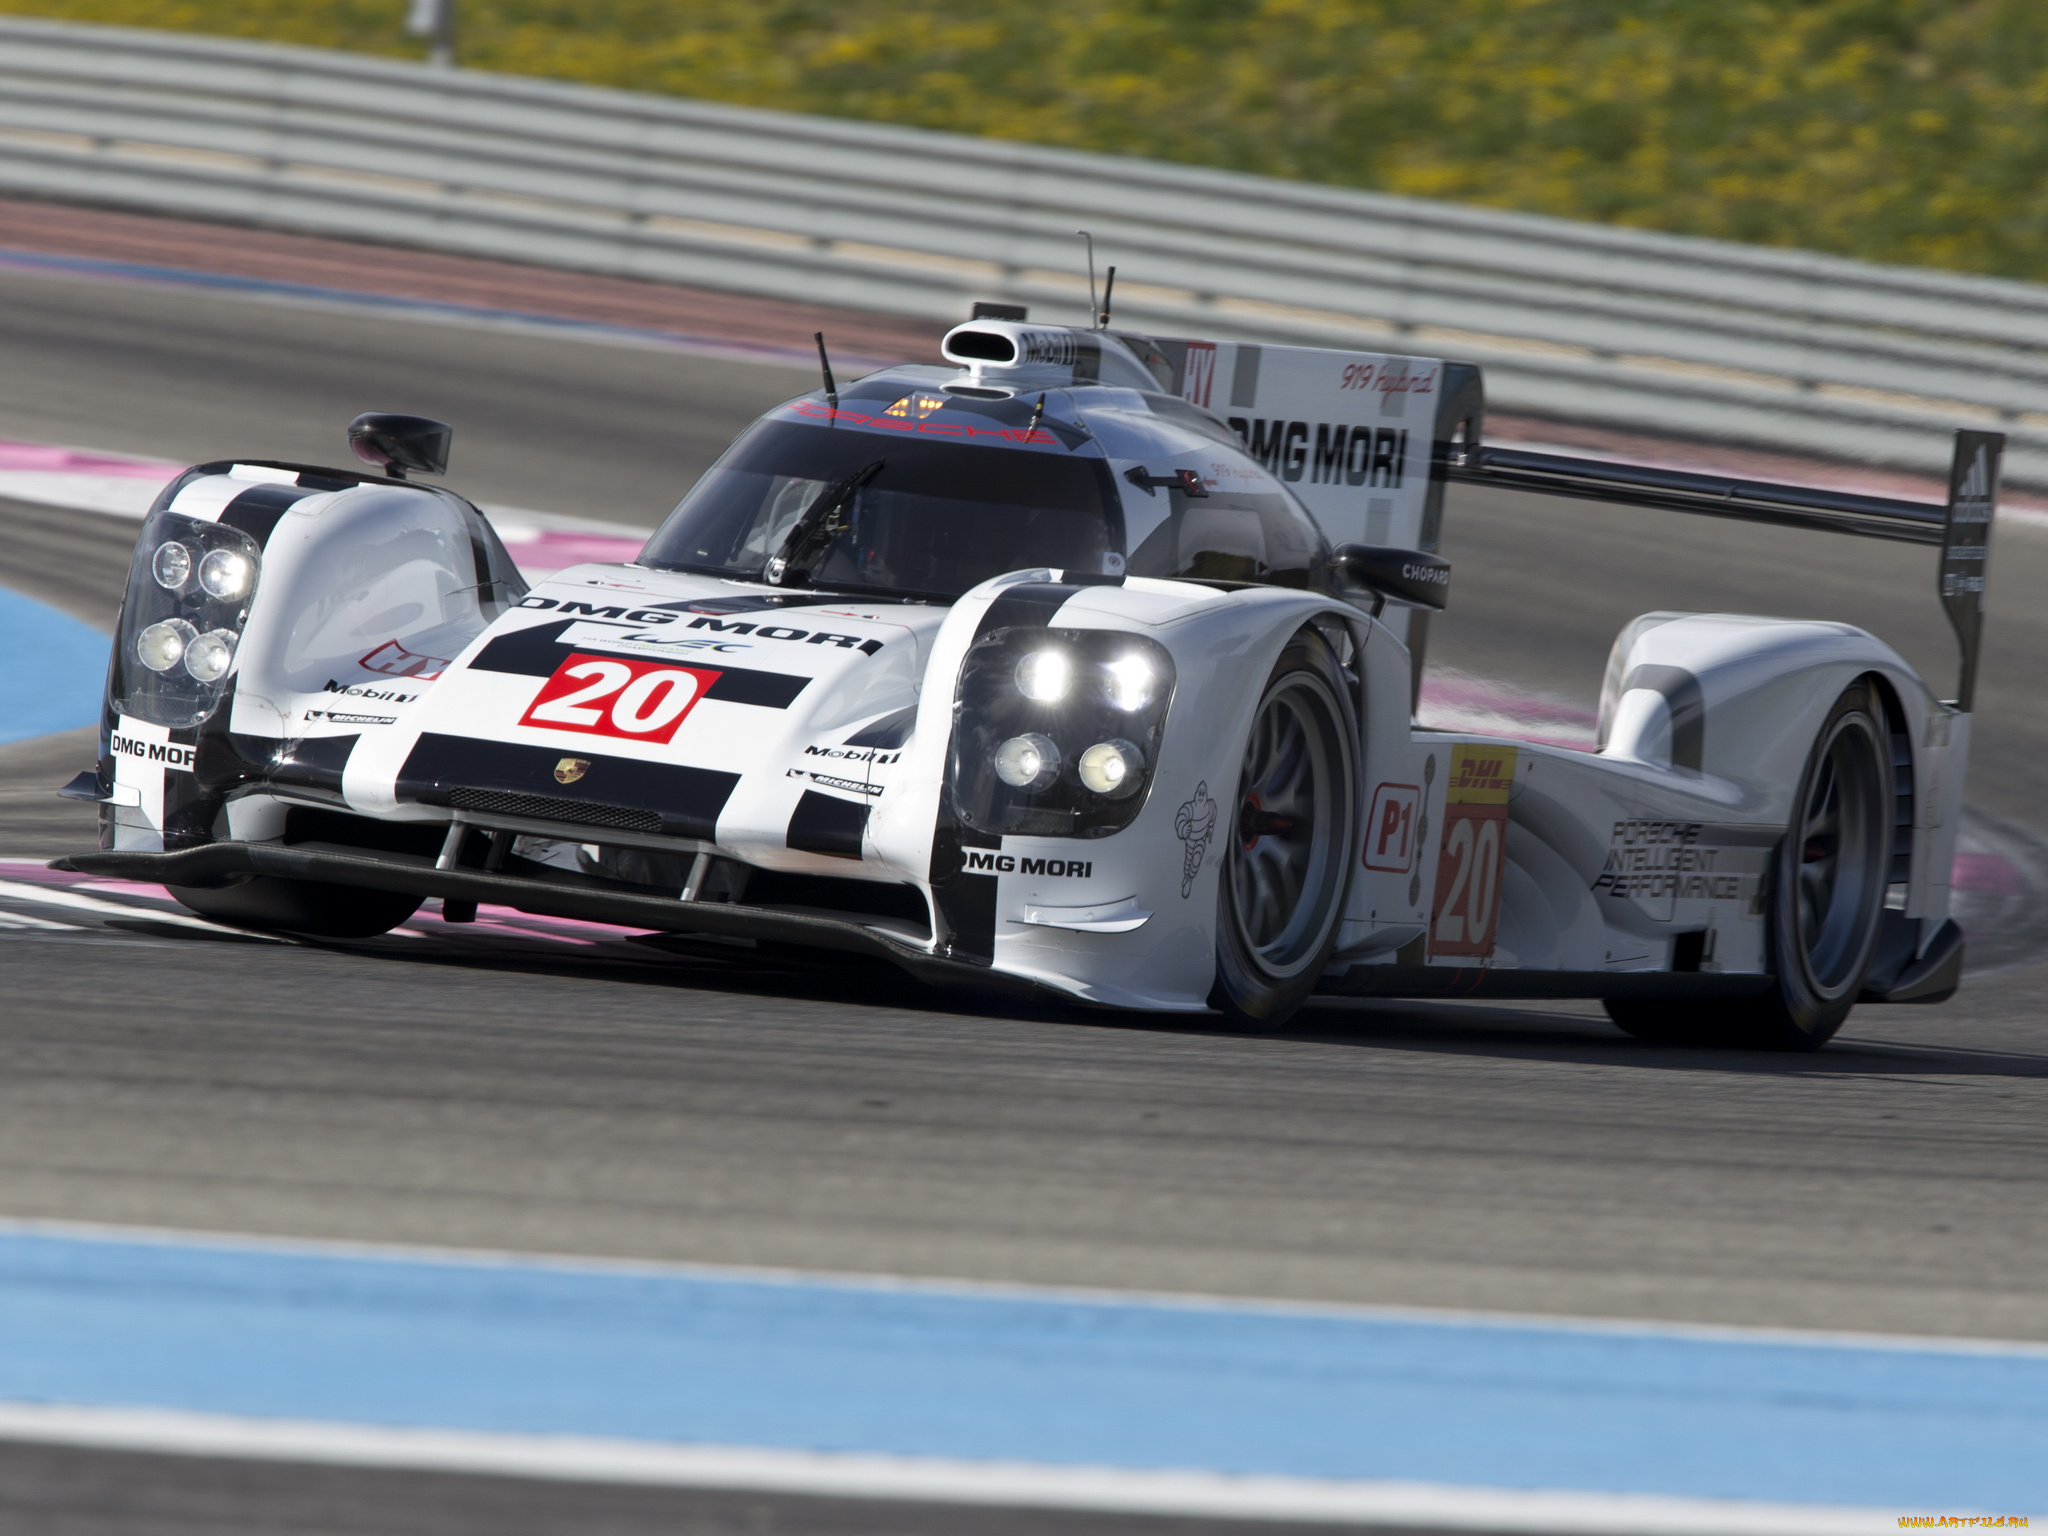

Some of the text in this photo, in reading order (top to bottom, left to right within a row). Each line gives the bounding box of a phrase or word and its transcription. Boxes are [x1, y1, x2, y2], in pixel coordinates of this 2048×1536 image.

[1340, 363, 1375, 390] 919
[783, 401, 1057, 444] PORSCHE
[1311, 423, 1409, 489] MORI
[516, 597, 884, 656] DMG MORI
[323, 679, 395, 701] Mobil
[530, 661, 698, 733] 20
[331, 713, 396, 725] MICHELIN
[112, 734, 145, 758] DMG
[804, 745, 878, 762] Mobil
[815, 775, 883, 794] MICHELIN
[1454, 759, 1509, 789] DHL
[1377, 799, 1412, 858] P1
[1611, 821, 1703, 845] PORSCHE
[1020, 857, 1093, 878] MORI
[1603, 848, 1719, 872] INTELLIGENT
[1434, 818, 1500, 945] 20
[1590, 873, 1740, 899] PERFORMANCE
